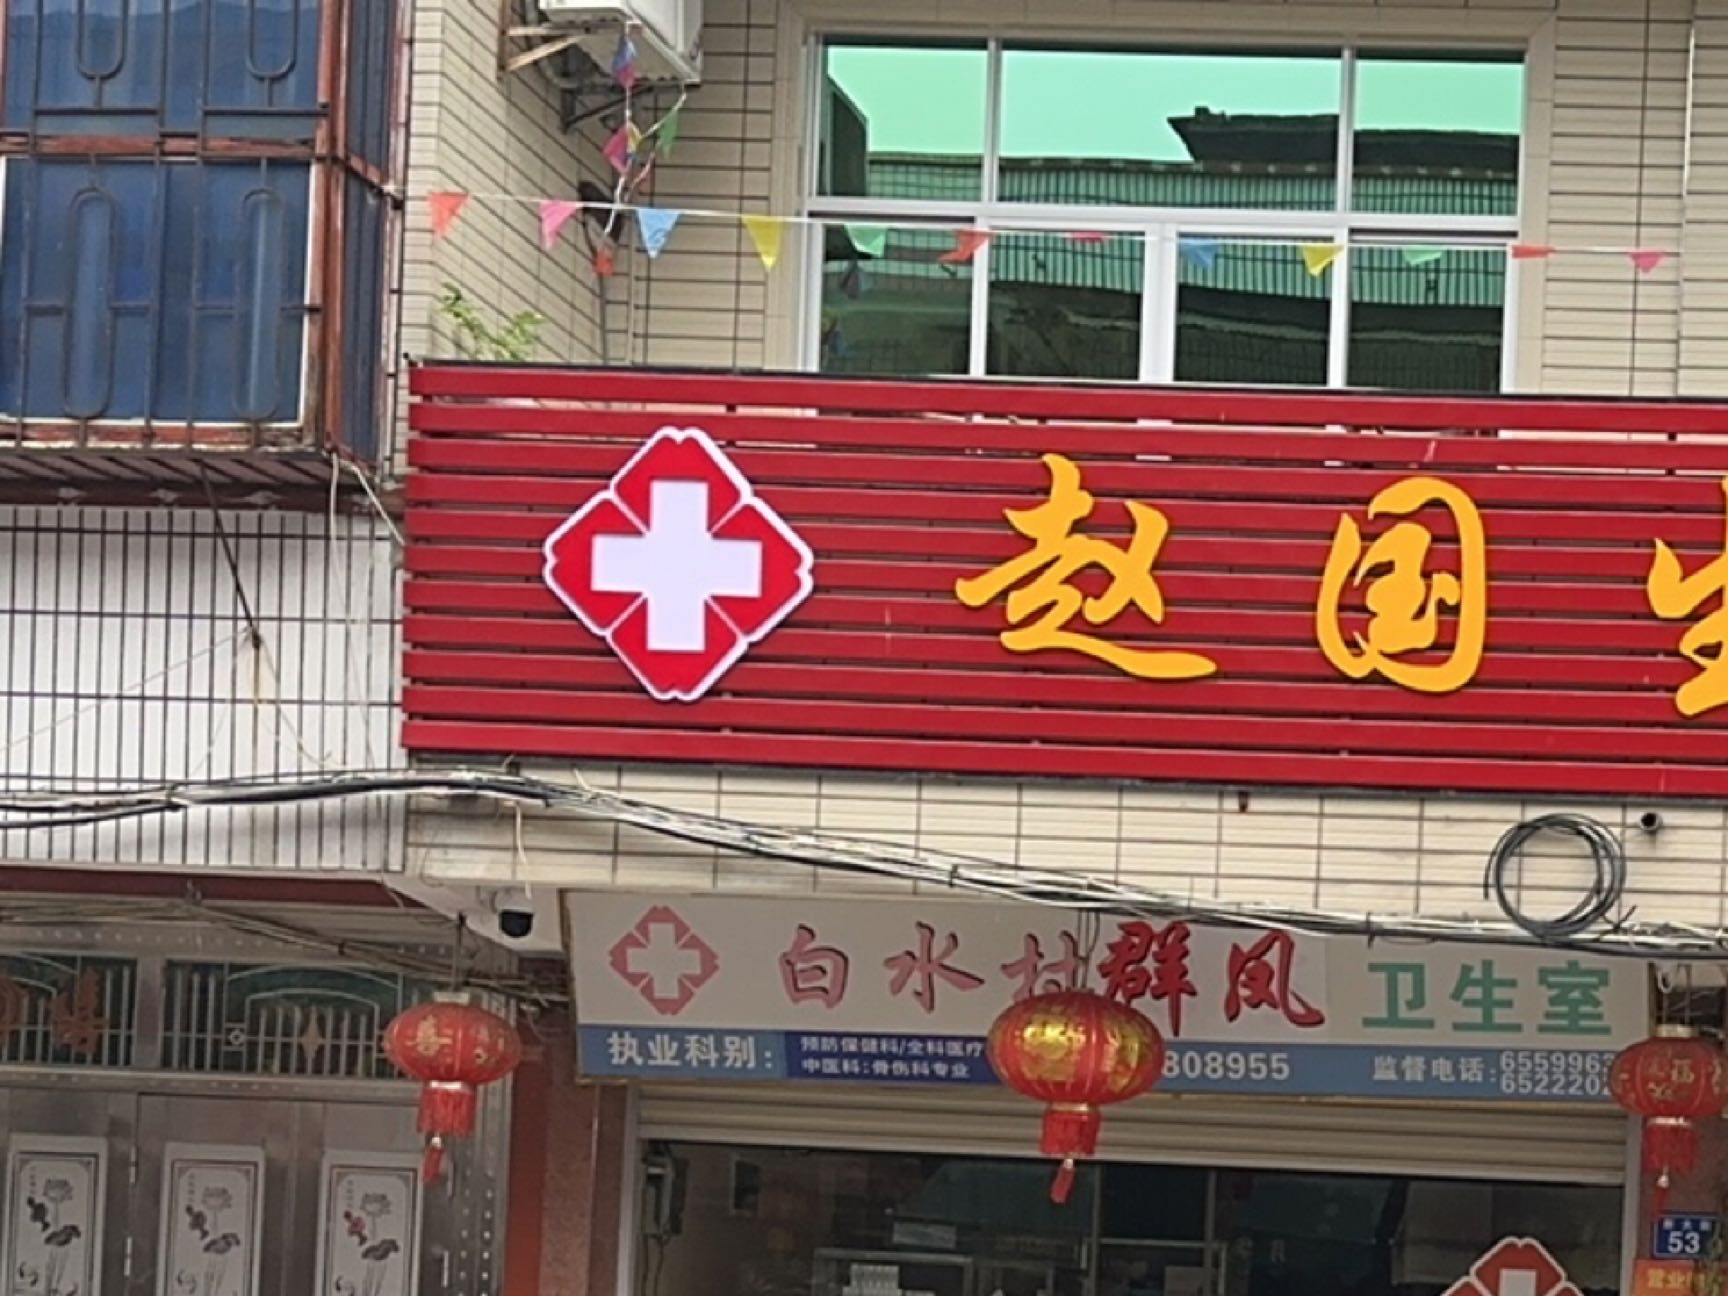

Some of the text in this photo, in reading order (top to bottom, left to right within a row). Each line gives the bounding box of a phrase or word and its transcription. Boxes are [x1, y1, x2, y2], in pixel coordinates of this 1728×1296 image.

[1362, 960, 1613, 1036] 卫生室
[1667, 1230, 1700, 1254] 53
